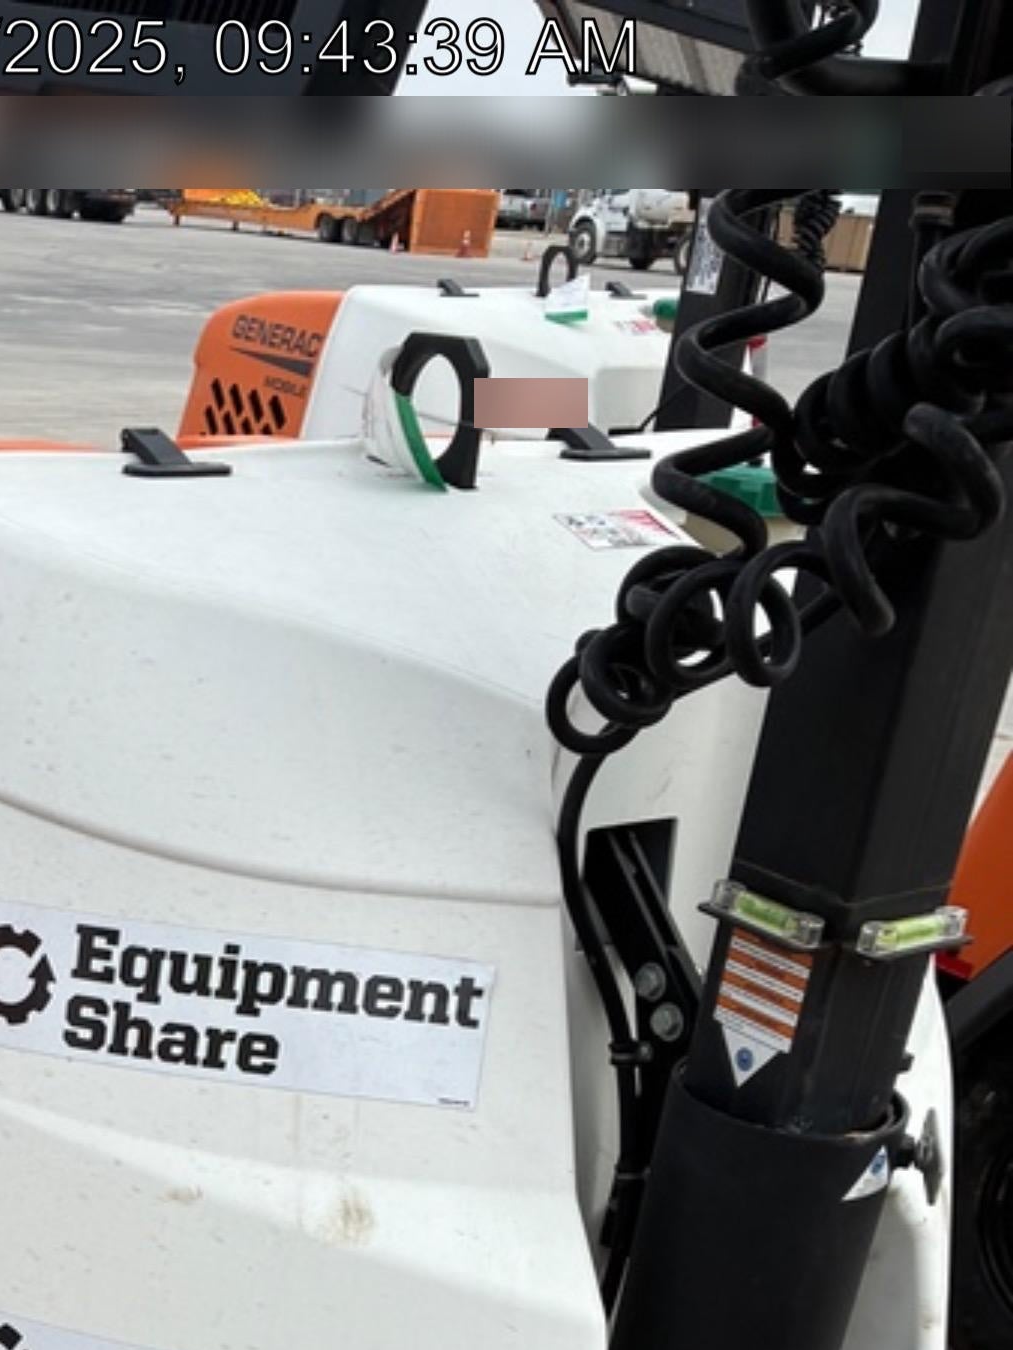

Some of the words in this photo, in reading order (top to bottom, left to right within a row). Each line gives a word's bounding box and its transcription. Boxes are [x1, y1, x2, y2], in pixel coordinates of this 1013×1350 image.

[232, 314, 326, 358] GENERAC
[70, 923, 485, 1029] Equipment
[63, 995, 280, 1076] Share
